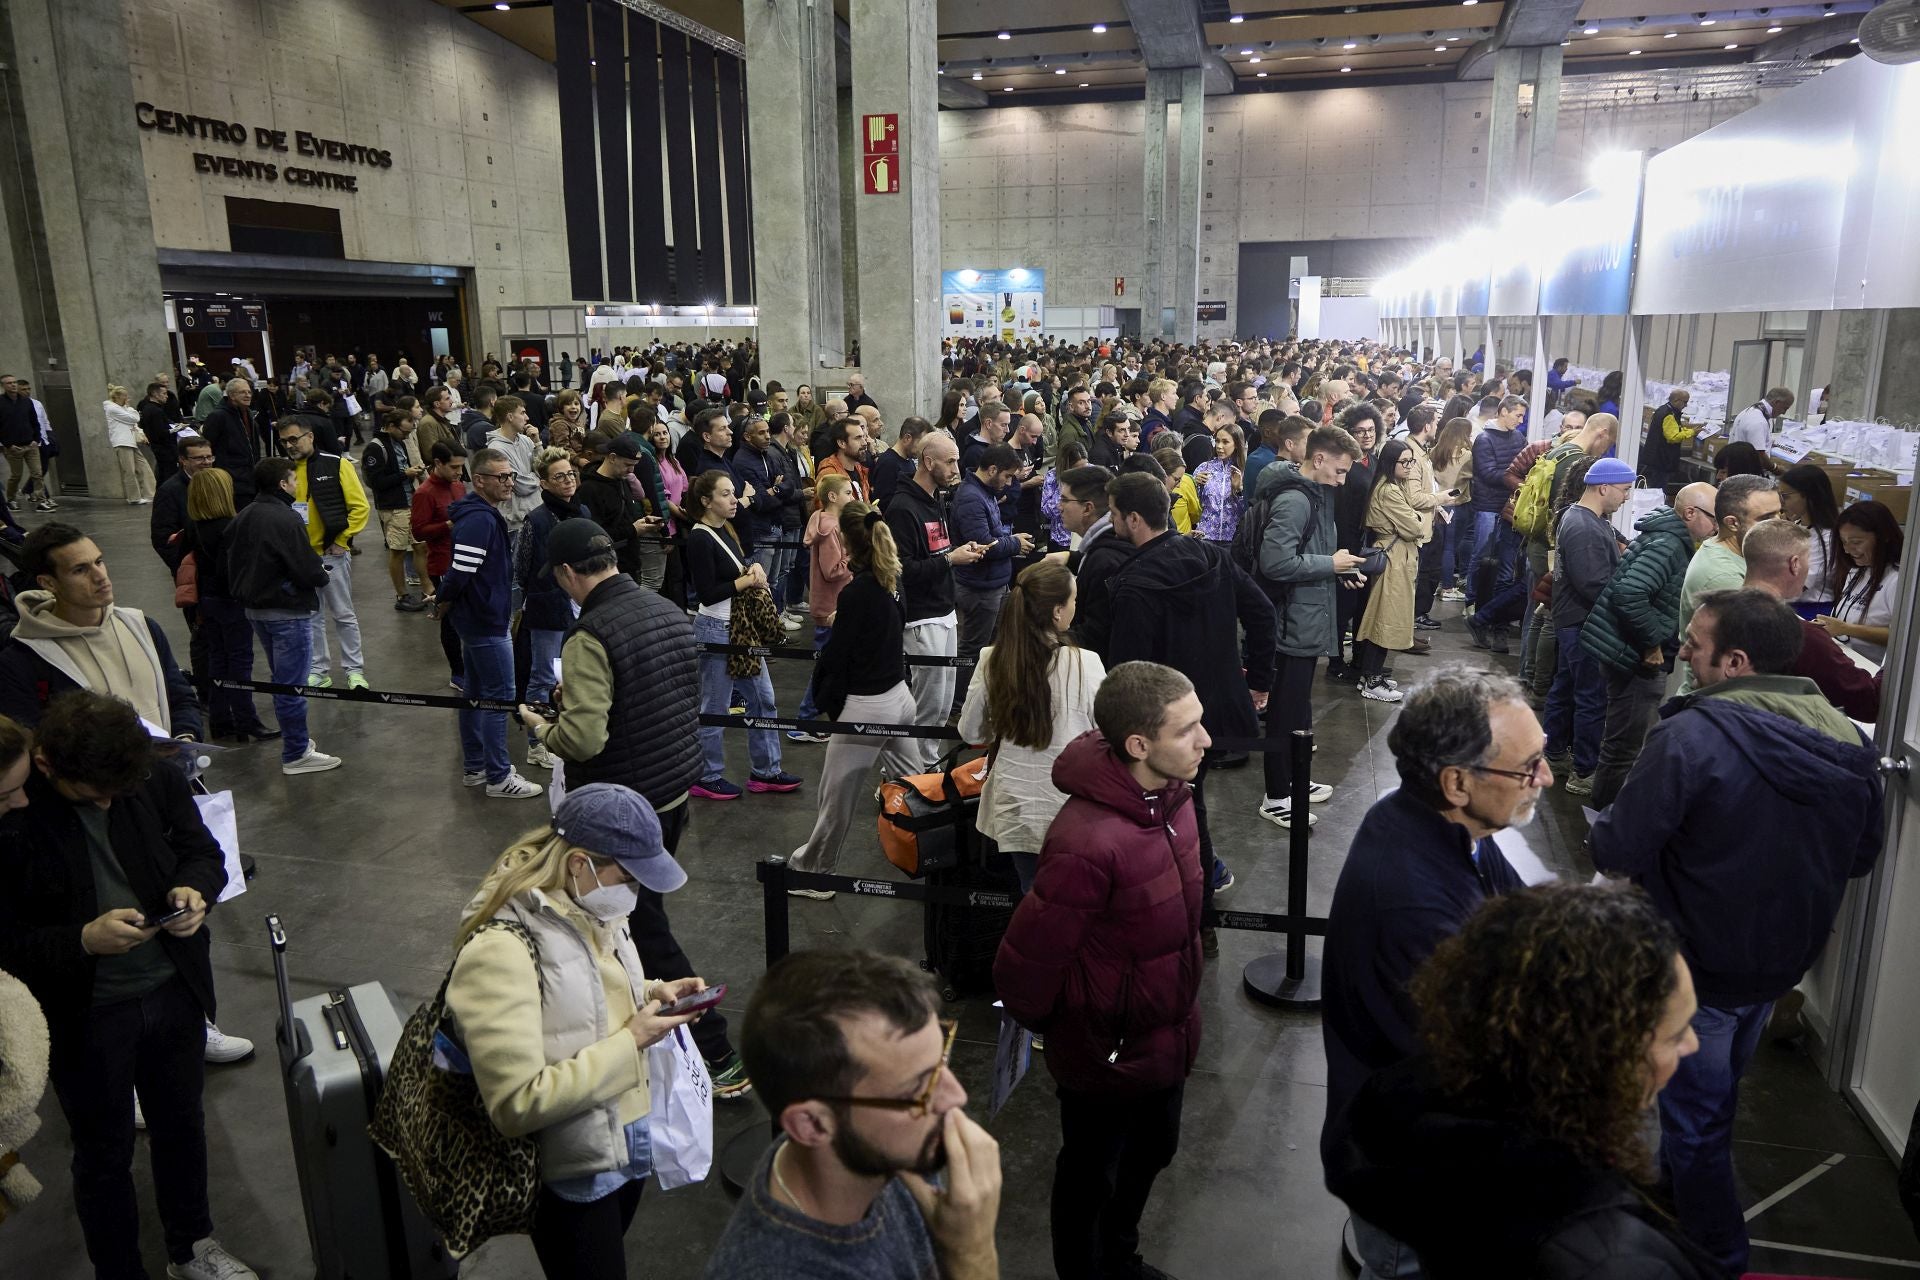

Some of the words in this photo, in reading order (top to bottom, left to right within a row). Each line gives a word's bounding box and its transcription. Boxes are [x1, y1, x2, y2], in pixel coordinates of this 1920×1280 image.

[254, 127, 289, 152] DE
[193, 152, 279, 181] EVENTS
[283, 166, 359, 193] CENTRE
[428, 311, 444, 322] WC
